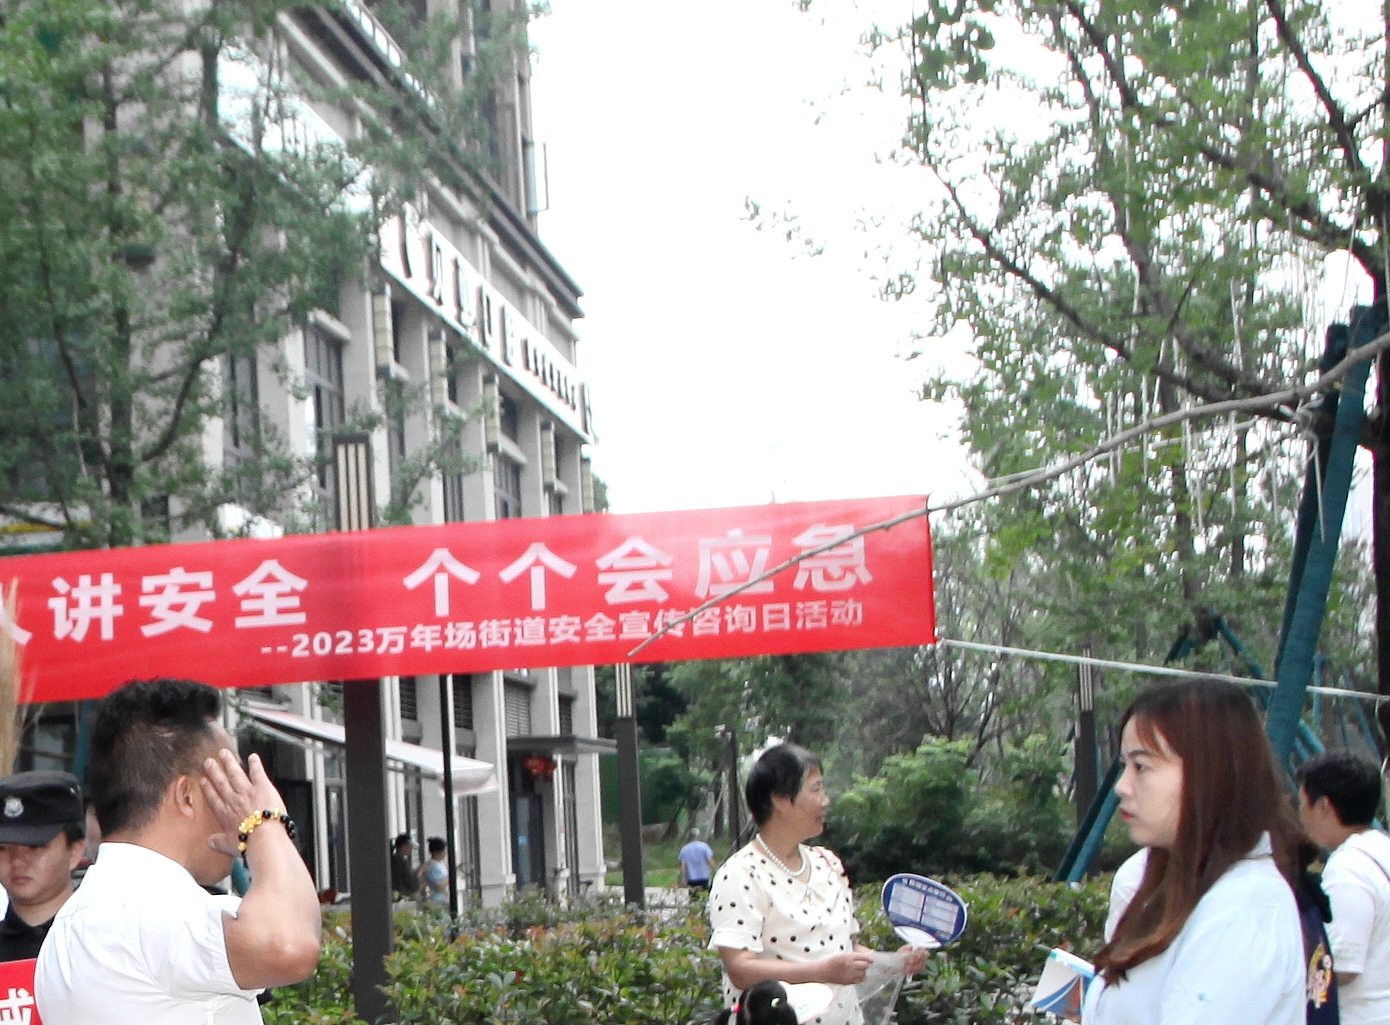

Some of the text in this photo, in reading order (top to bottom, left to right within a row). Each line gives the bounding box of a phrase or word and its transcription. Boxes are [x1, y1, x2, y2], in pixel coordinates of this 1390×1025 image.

[403, 523, 873, 617] 个个会应急
